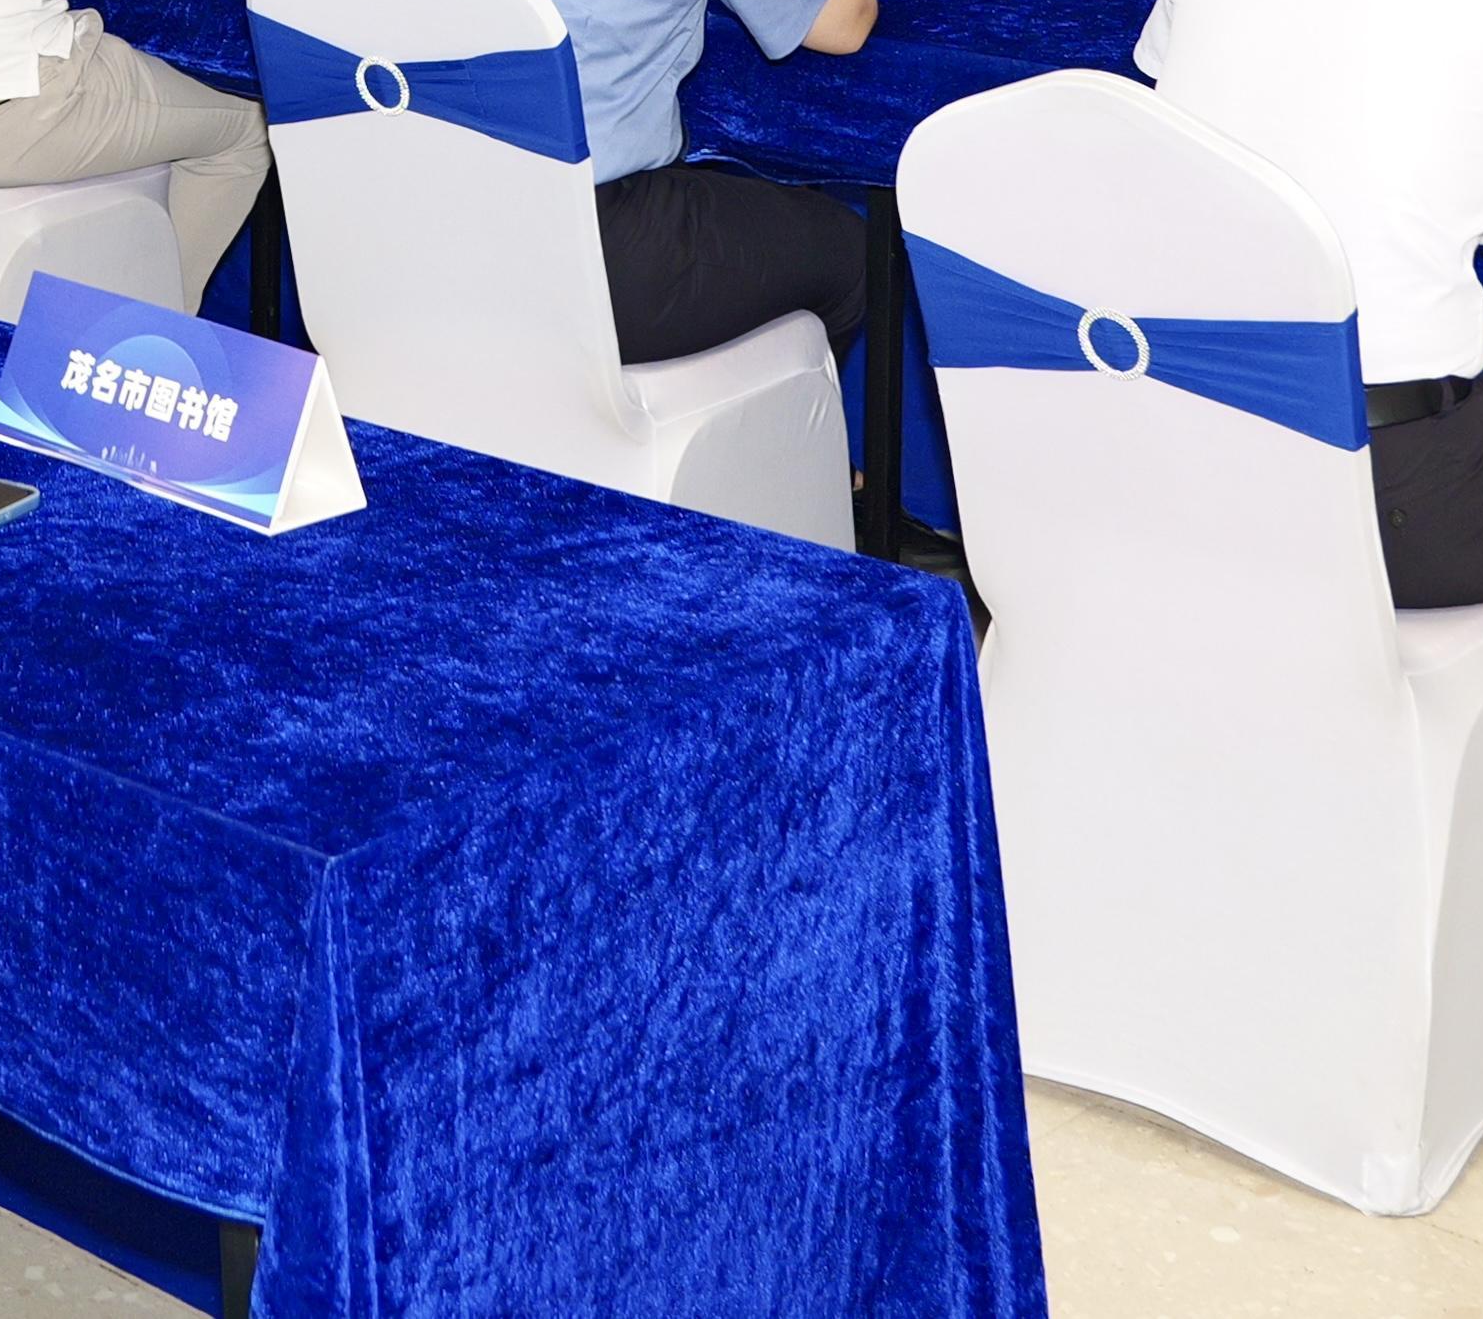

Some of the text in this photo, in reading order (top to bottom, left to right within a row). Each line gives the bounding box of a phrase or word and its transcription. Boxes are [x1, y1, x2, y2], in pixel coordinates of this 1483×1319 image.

[59, 347, 240, 444] 茂名市图书馆
